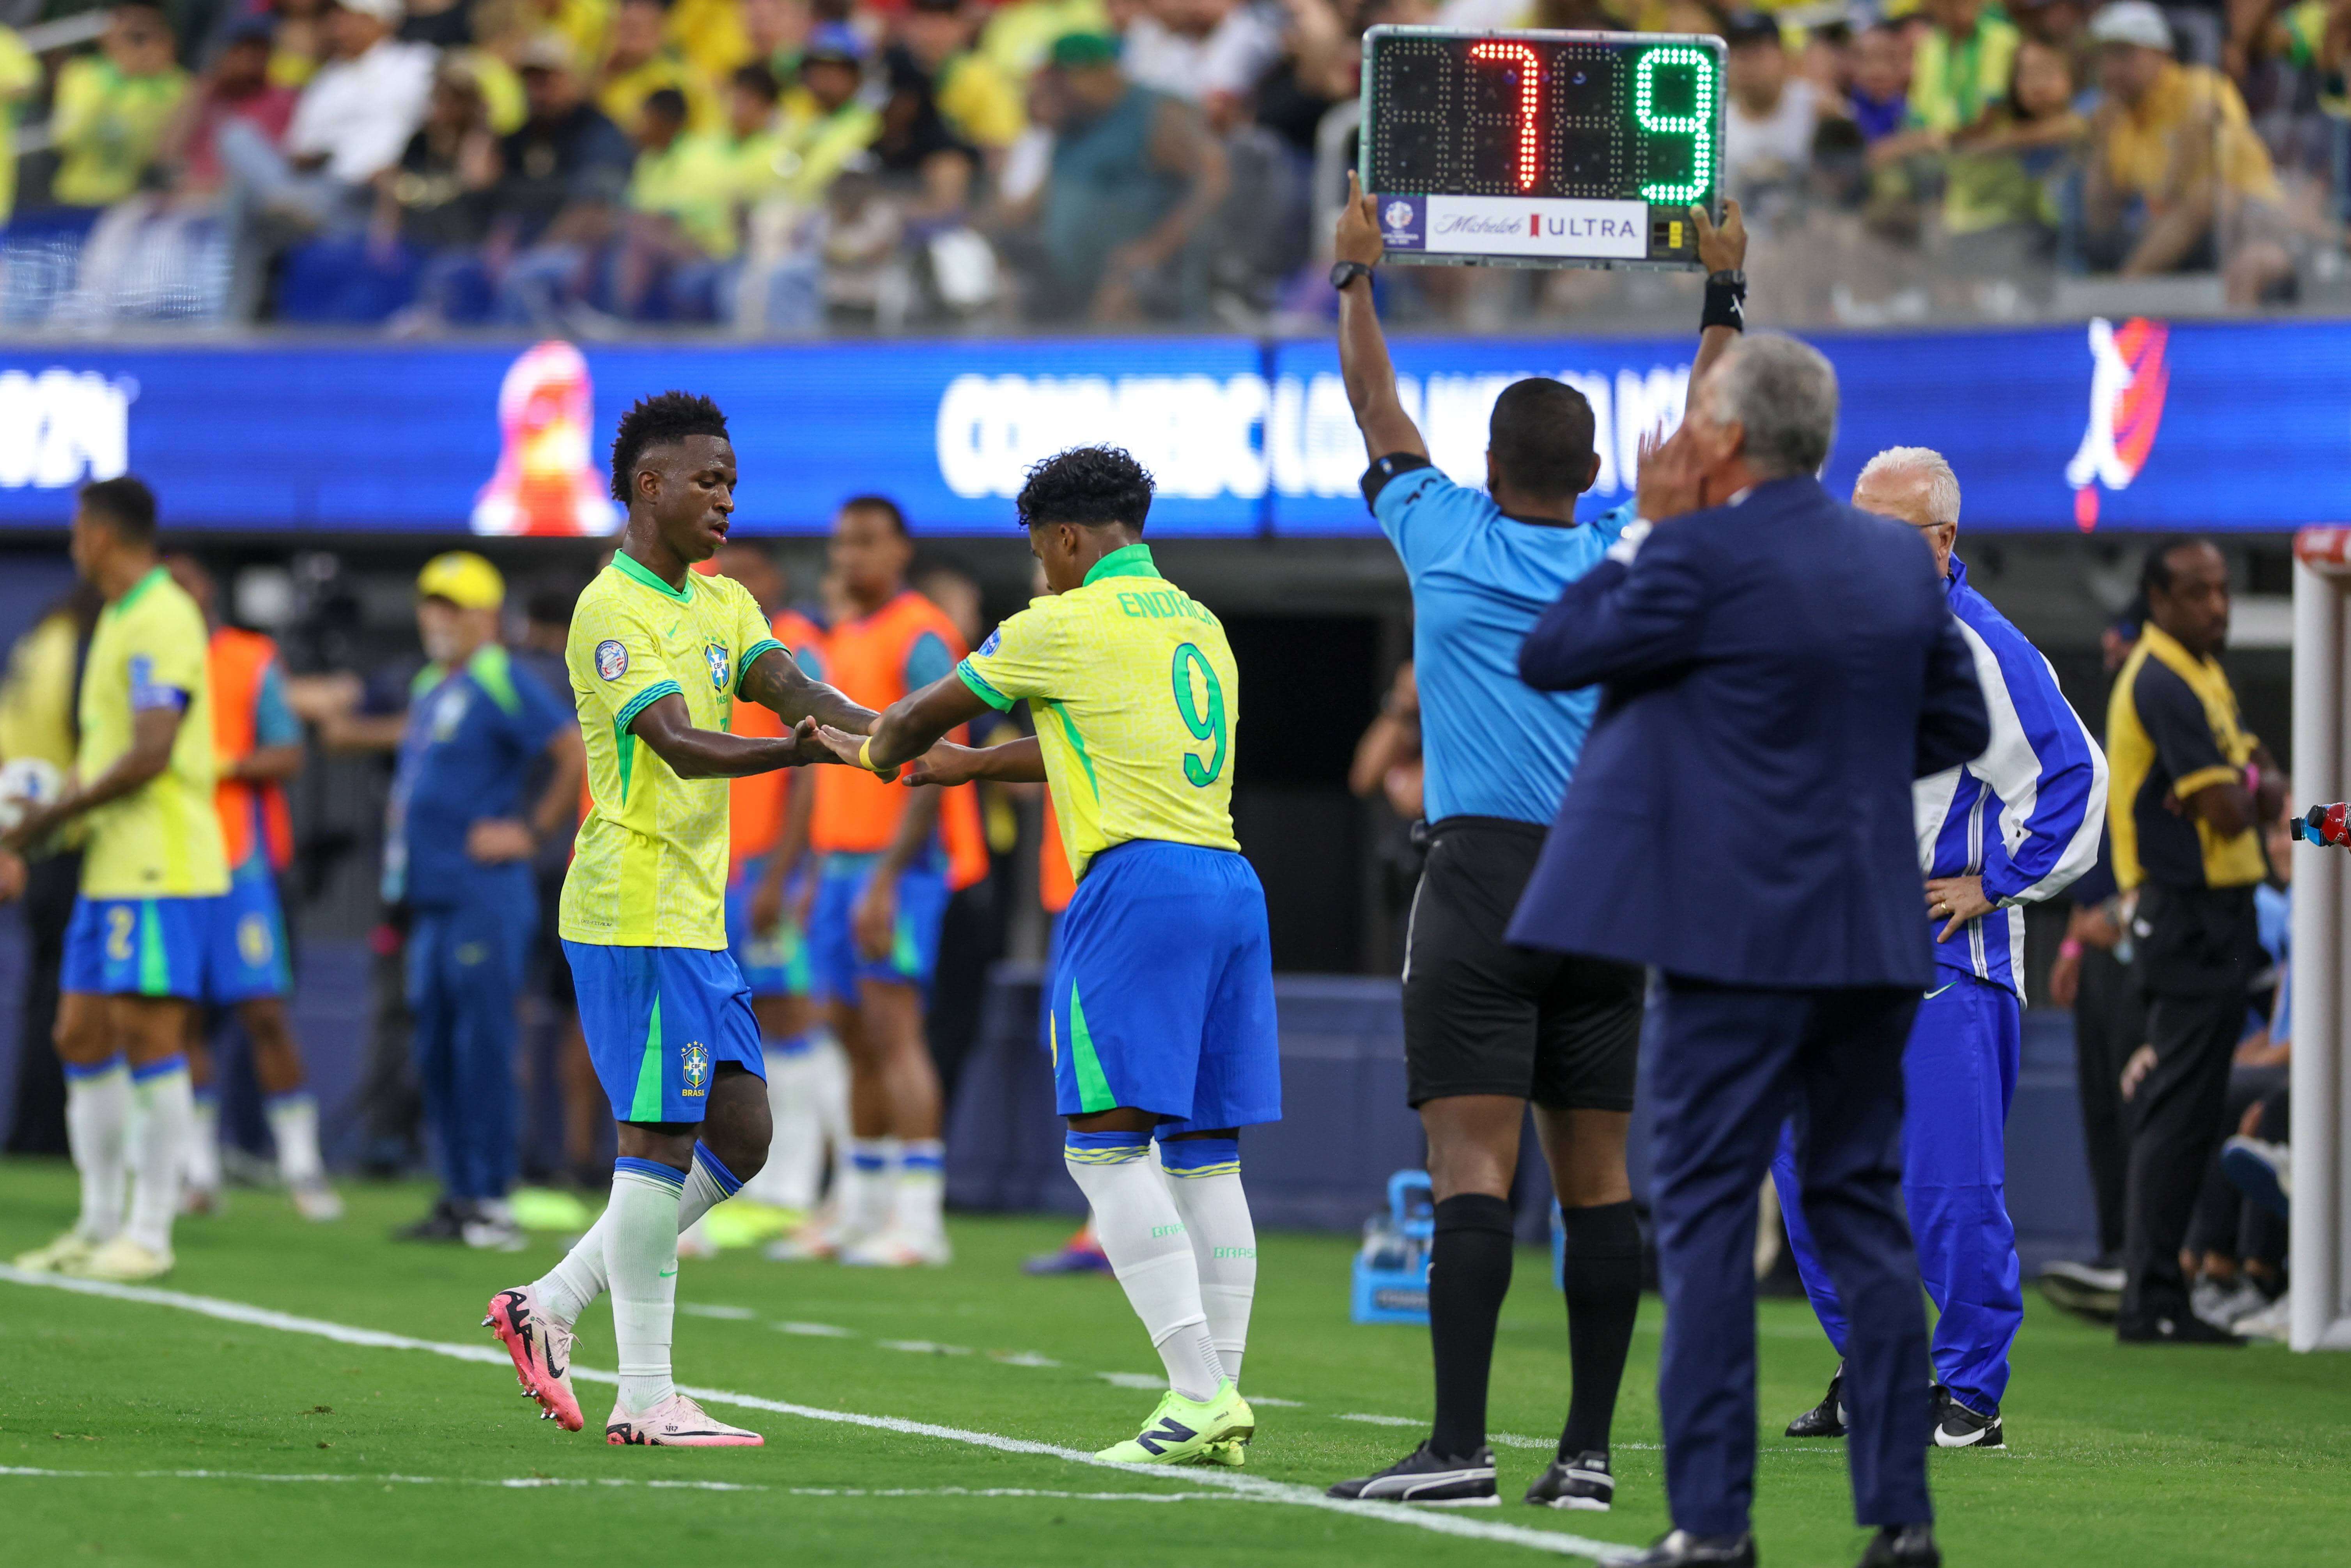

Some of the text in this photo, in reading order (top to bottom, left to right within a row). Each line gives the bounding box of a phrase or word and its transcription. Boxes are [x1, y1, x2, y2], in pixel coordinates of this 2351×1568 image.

[1471, 43, 1712, 200] 7 9
[1548, 218, 1637, 237] ULTRA
[1172, 642, 1226, 788] 9
